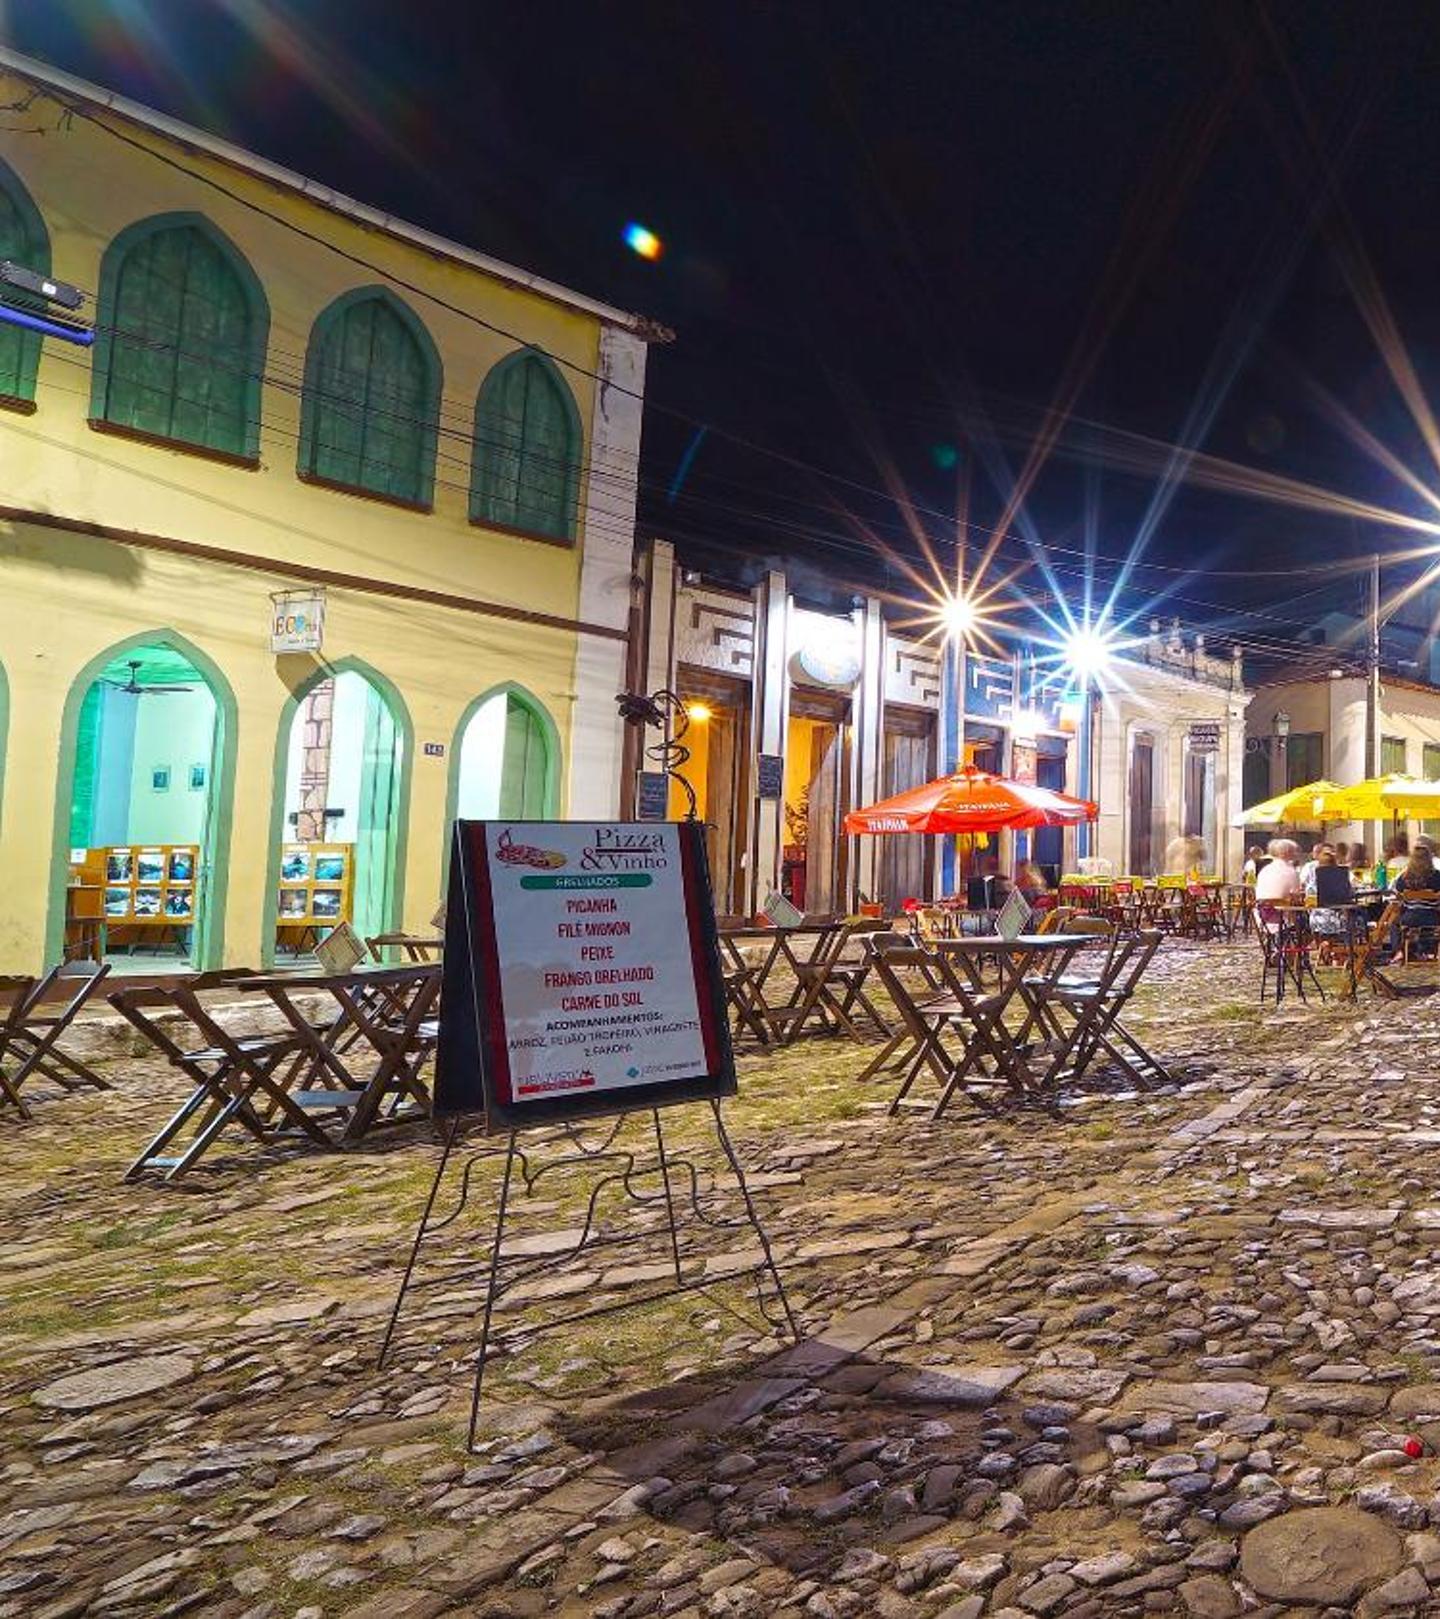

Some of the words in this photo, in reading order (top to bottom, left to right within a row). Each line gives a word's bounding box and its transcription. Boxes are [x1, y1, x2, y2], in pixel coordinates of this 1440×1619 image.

[595, 828, 667, 852] Pizza
[602, 853, 668, 870] Vinho
[566, 898, 618, 914] PICANHA
[585, 921, 631, 937] MIGNON
[581, 946, 615, 961] PEIXE
[545, 971, 593, 988] FRANGO
[594, 966, 654, 984] GRELHADO
[561, 995, 602, 1012] CARNE
[604, 993, 620, 1009] DO
[622, 991, 644, 1007] SOL
